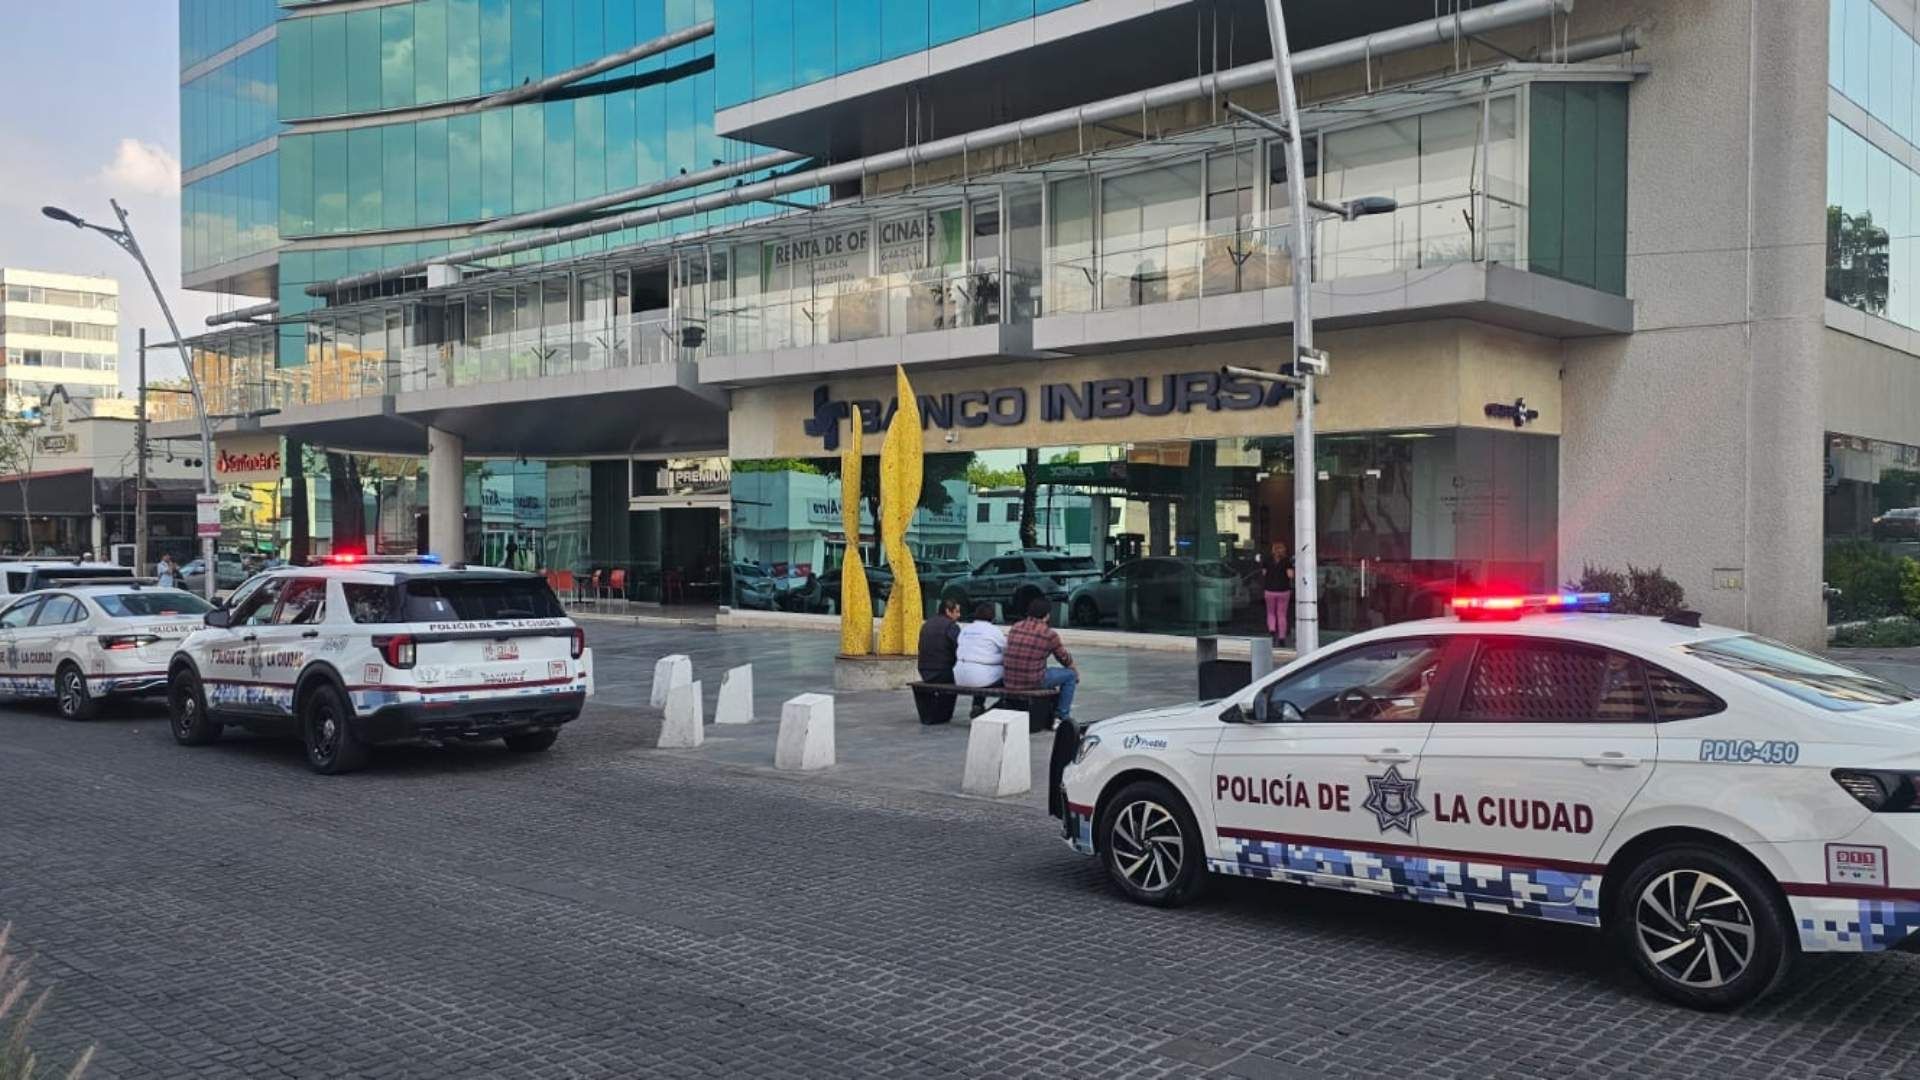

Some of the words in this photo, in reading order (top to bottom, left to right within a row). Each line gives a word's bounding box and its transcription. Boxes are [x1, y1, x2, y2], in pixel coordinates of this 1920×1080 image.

[776, 239, 821, 264] RENTA
[825, 234, 842, 254] DE
[675, 469, 730, 483] PREMIUM
[1700, 739, 1799, 764] PDLC-450
[1216, 773, 1310, 809] POLICÍA
[1318, 783, 1351, 812] DE
[1434, 792, 1471, 824] LA
[1478, 796, 1594, 835] CIUDAD
[1836, 850, 1876, 865] 911
